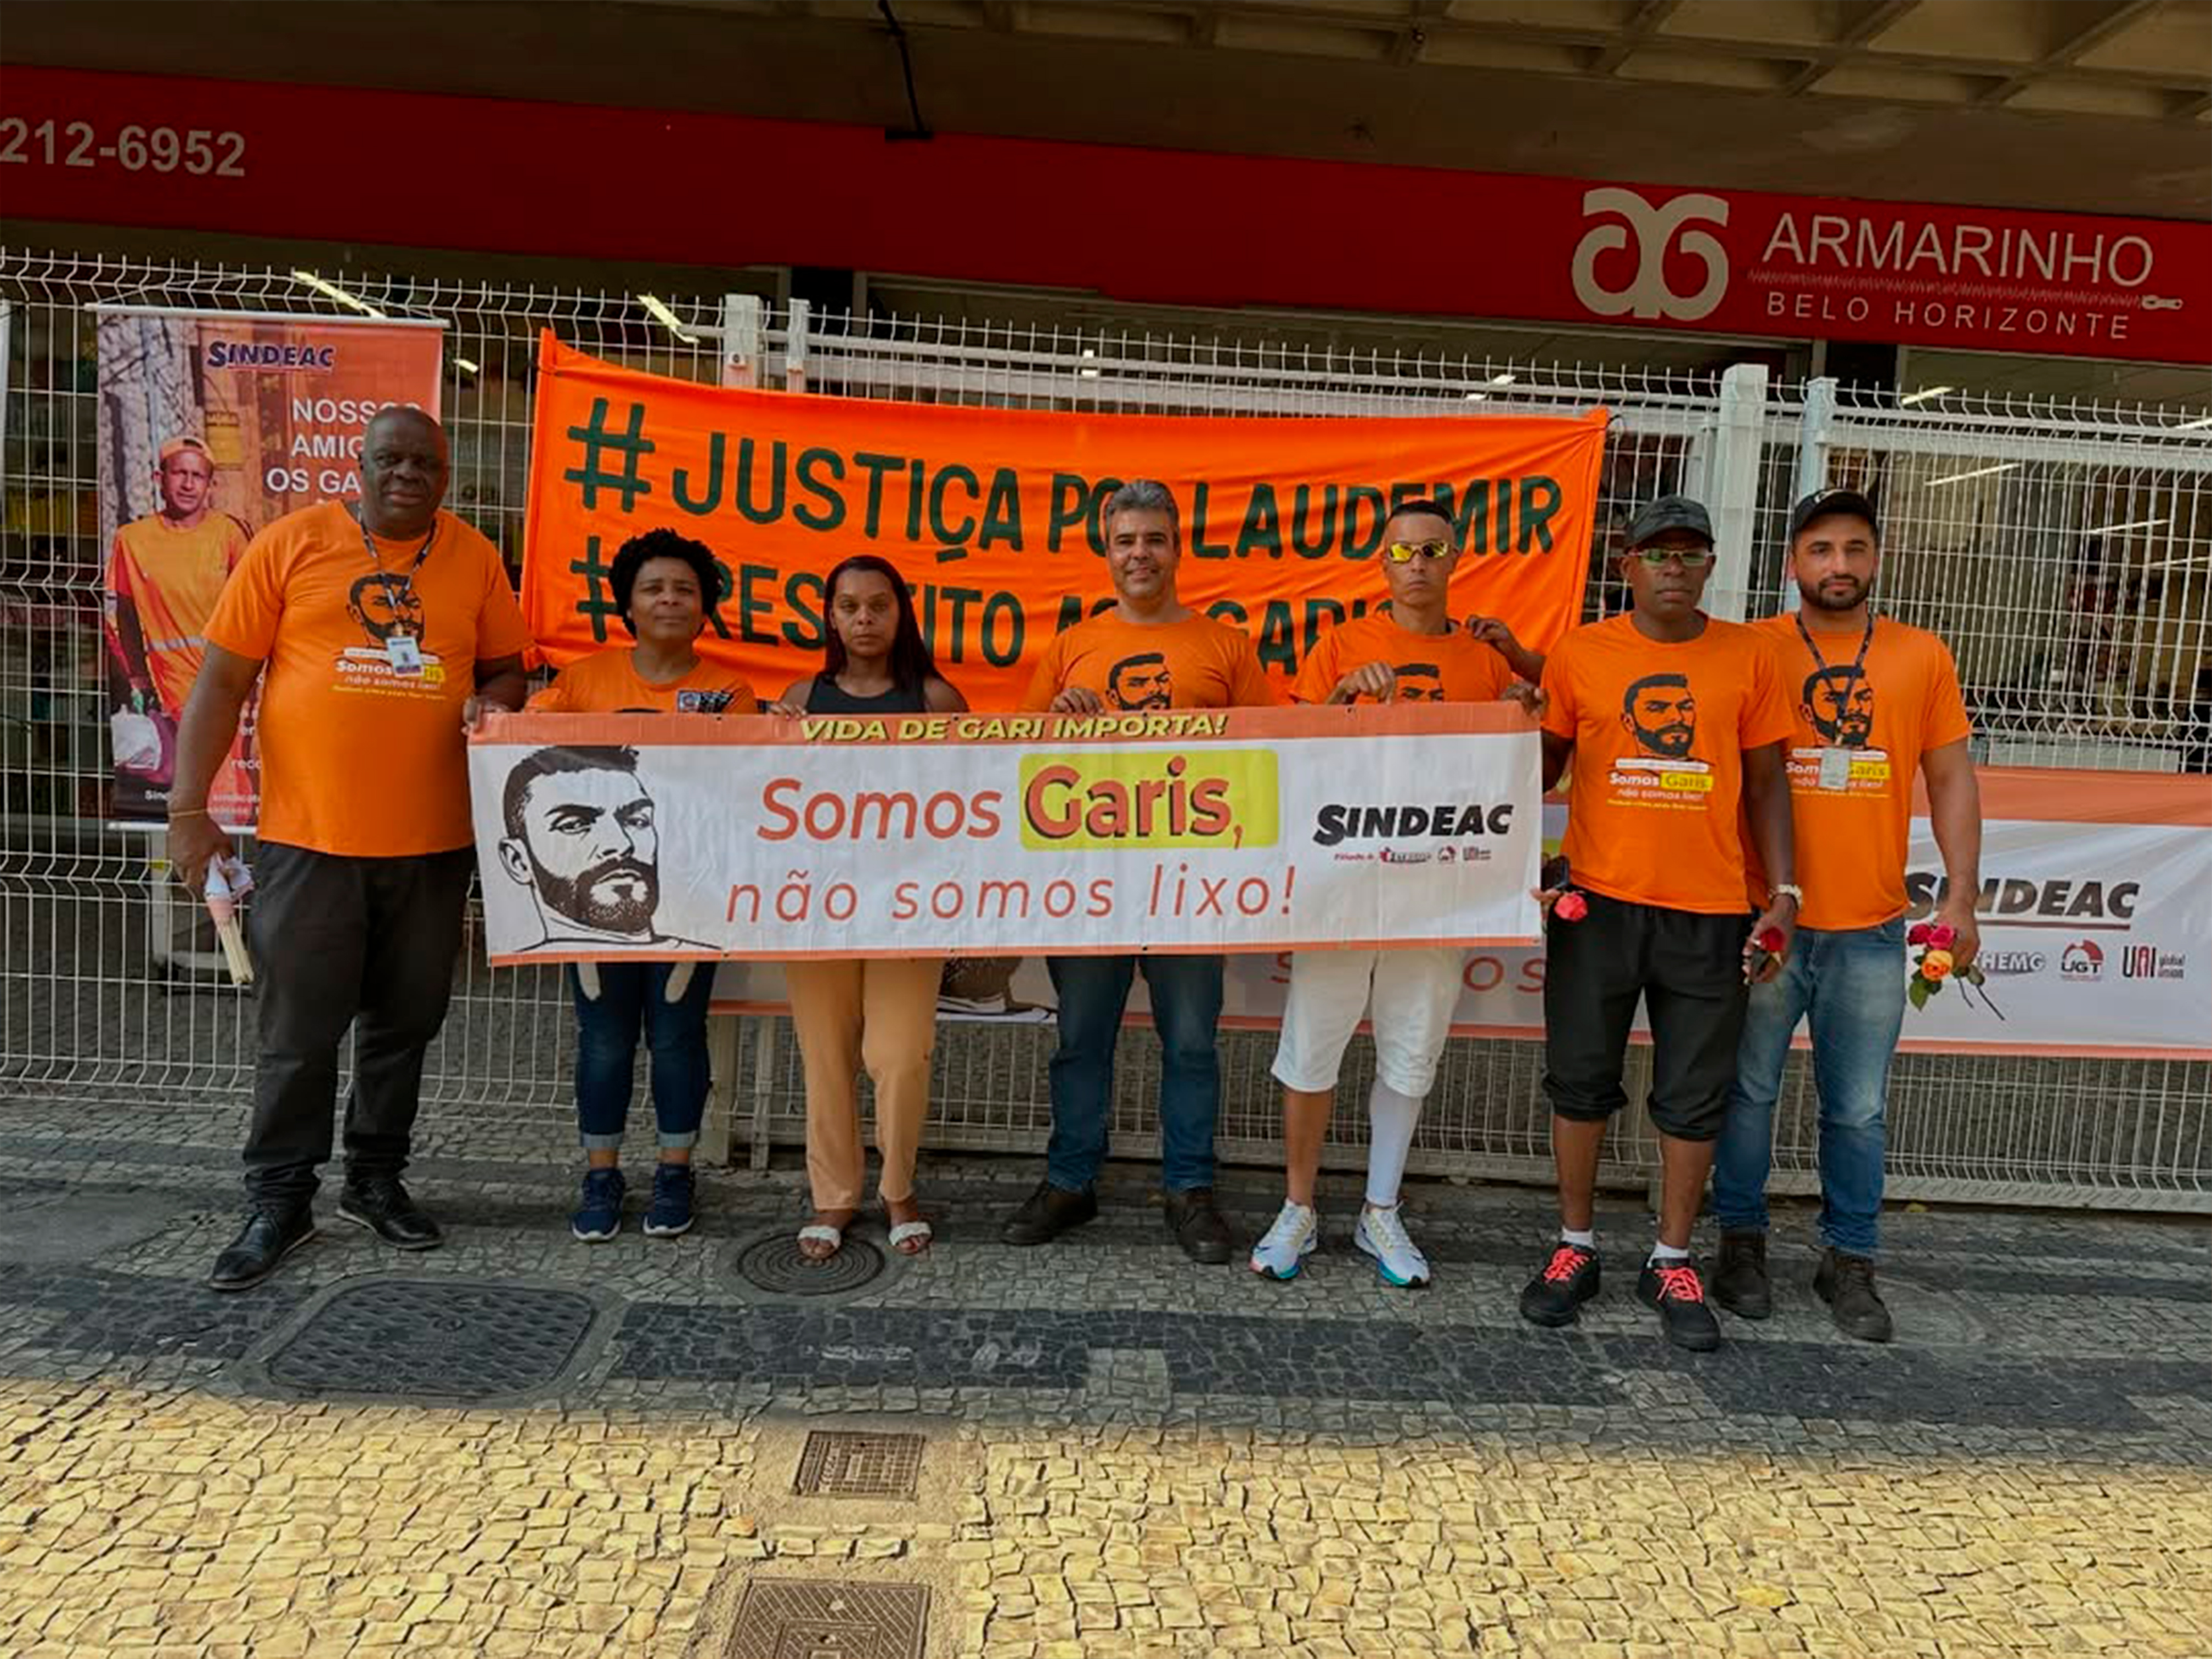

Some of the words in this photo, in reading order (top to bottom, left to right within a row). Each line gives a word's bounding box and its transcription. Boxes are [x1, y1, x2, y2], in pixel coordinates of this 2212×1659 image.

[1762, 212, 2153, 287] ARMARINHO
[1767, 291, 1869, 321] BELO
[1894, 301, 2130, 339] HORIZONTE
[207, 340, 334, 368] SINDEAC
[292, 398, 421, 425] NOSS
[266, 467, 309, 493] OS
[335, 660, 393, 676] Somos
[799, 719, 888, 741] VIDA
[898, 718, 949, 740] DE
[957, 716, 1044, 739] GARI
[1053, 714, 1229, 738] IMPORTA!
[1609, 772, 1660, 786] Somos
[1785, 761, 1819, 775] Som
[756, 777, 1003, 841] Somos
[1025, 755, 1244, 849] Garis,
[1312, 804, 1514, 847] SINDEAC
[726, 869, 858, 923] não
[892, 878, 1114, 920] somos
[1149, 863, 1297, 917] lixo!
[2061, 961, 2102, 974] UGT
